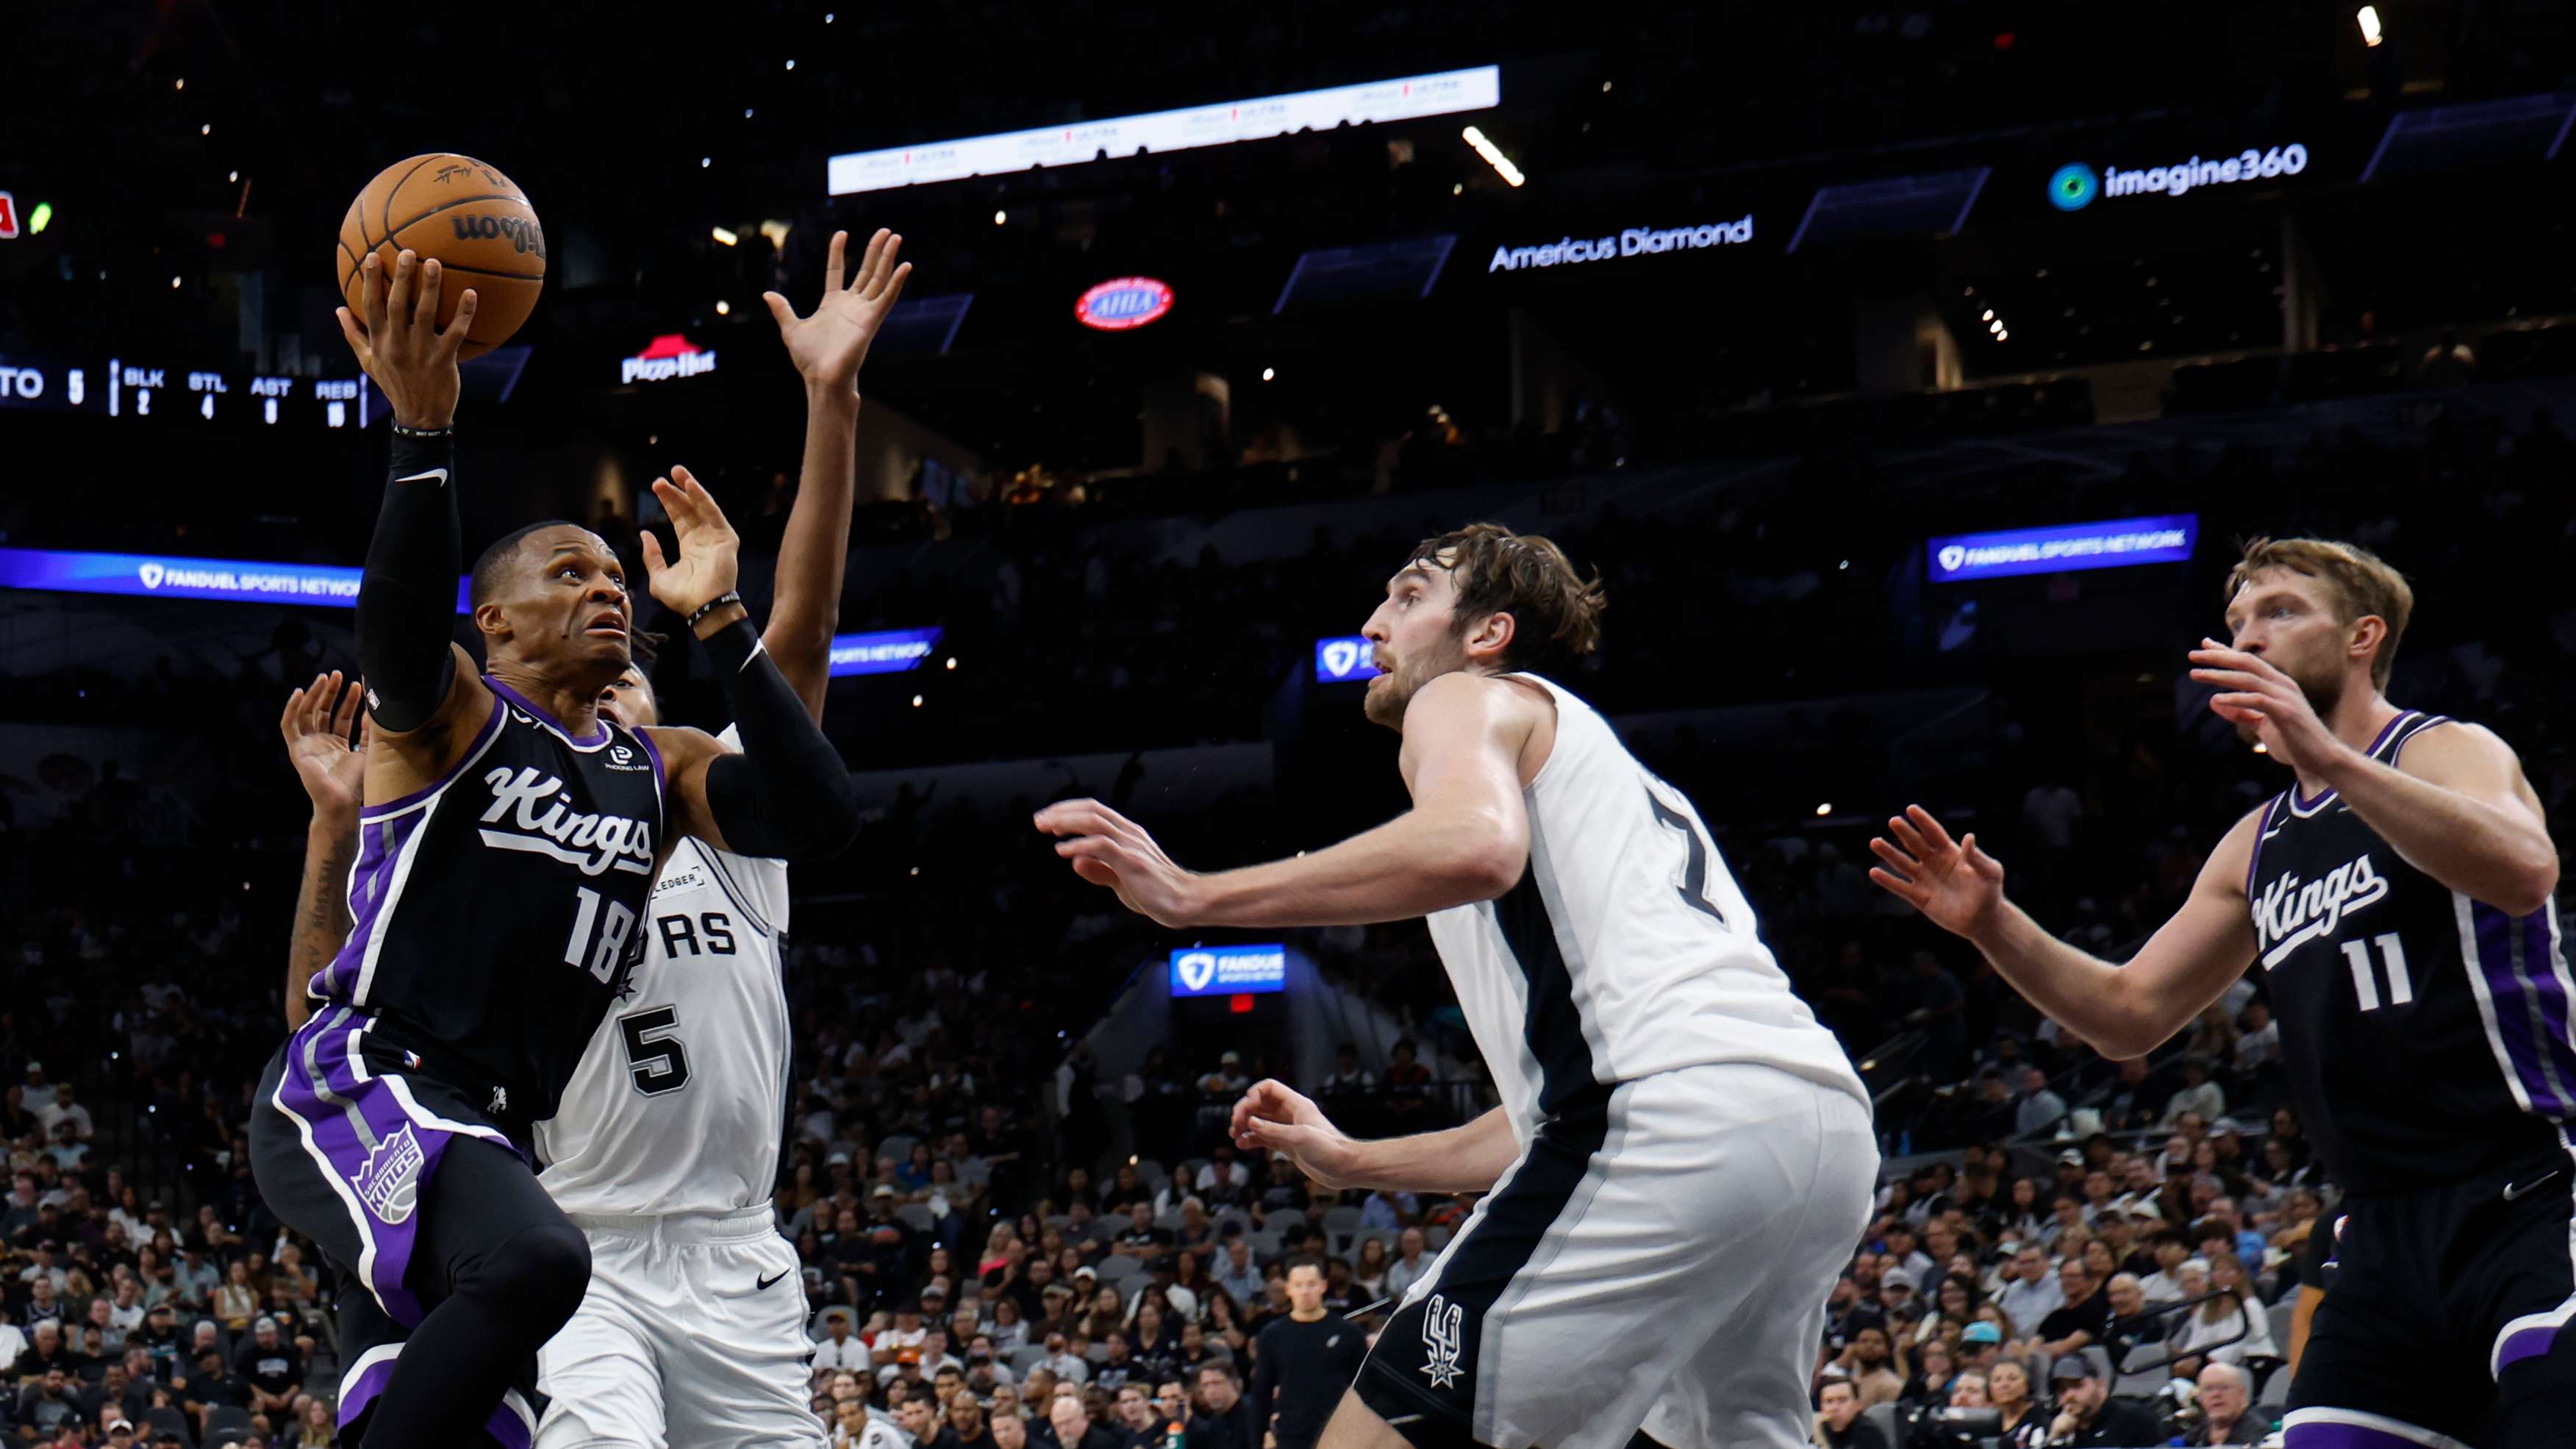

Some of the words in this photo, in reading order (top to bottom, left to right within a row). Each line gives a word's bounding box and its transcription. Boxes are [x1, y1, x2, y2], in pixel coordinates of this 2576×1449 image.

[2105, 143, 2308, 198] imagine360
[1489, 235, 1617, 273] Americus
[1620, 213, 1753, 257] Diamond
[68, 369, 85, 404] 5
[124, 367, 165, 388] BLK
[188, 371, 229, 393] STL
[250, 376, 293, 397] AST
[316, 380, 357, 400] REB
[622, 356, 677, 384] Pizza
[165, 569, 239, 590] FANDUEL
[240, 573, 298, 593] SPORTS
[299, 577, 360, 598] NETWOR
[479, 766, 654, 876] Kings
[564, 885, 635, 984] 18
[2251, 853, 2389, 972] Kings
[2340, 931, 2413, 1012] 11
[617, 1003, 693, 1098] 5
[369, 1146, 420, 1213] KINGS
